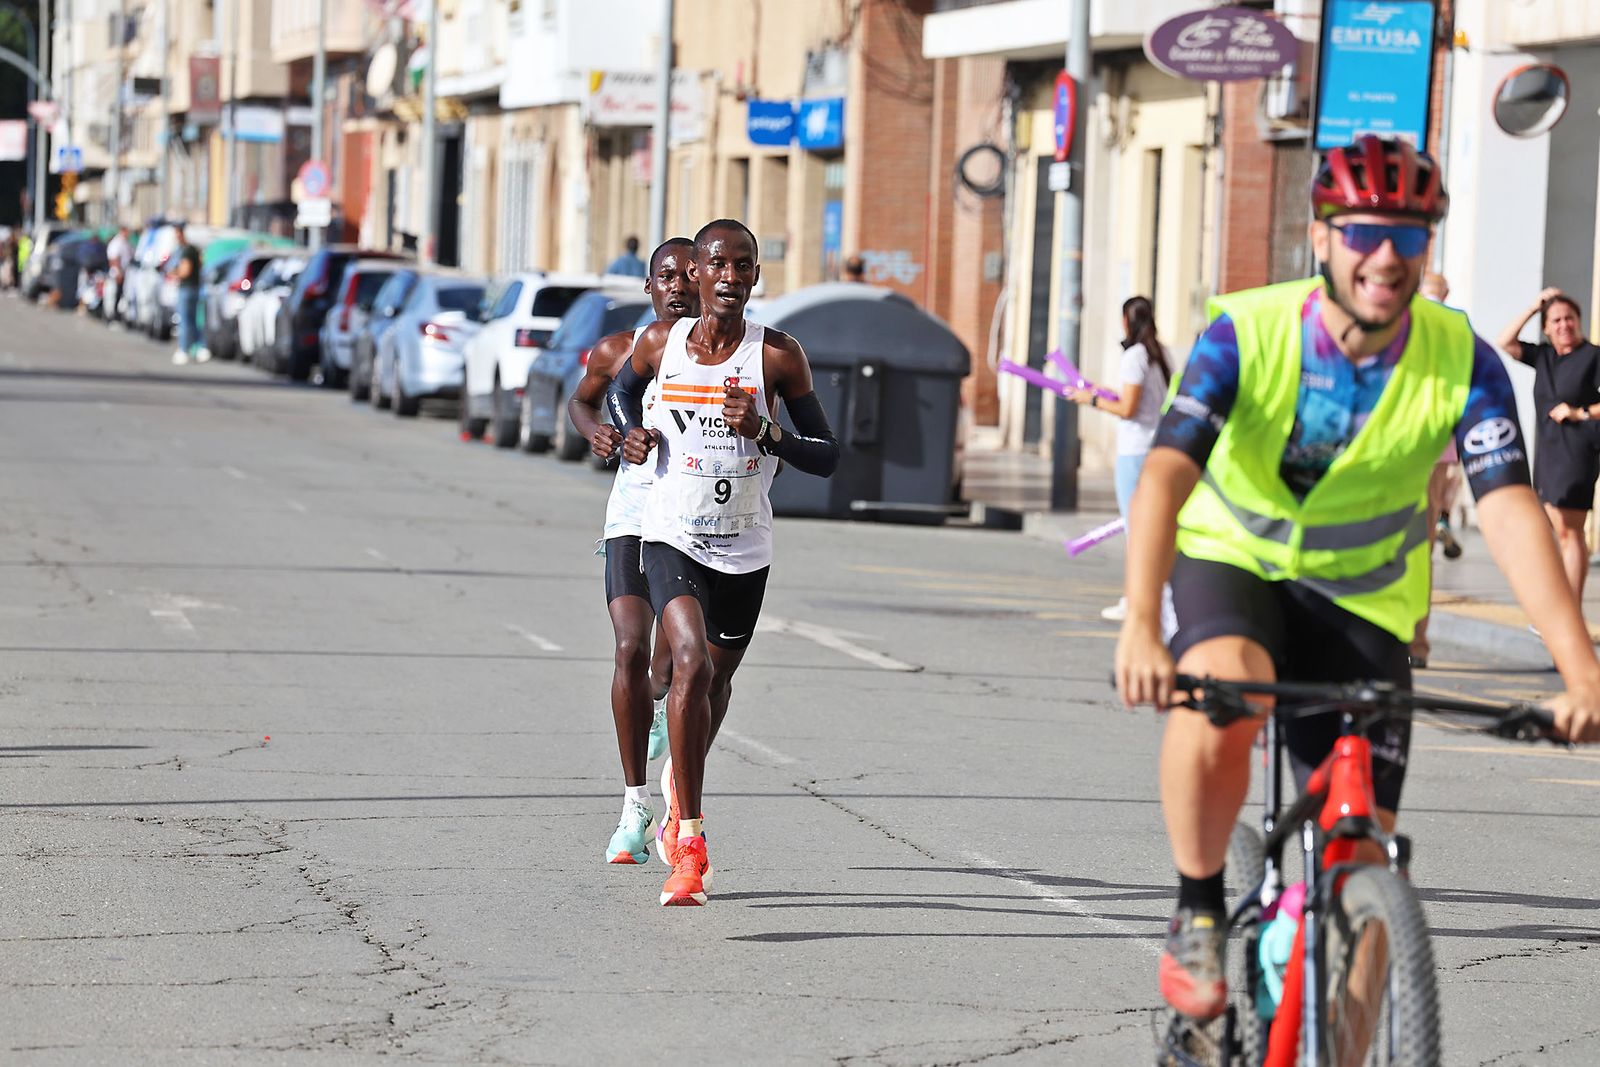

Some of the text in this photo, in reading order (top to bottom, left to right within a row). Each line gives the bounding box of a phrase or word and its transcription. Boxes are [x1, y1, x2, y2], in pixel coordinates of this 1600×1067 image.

[1330, 26, 1421, 48] EMTUSA
[686, 456, 704, 471] 2K
[746, 457, 761, 471] 2K
[1466, 449, 1524, 475] HUELVA
[714, 478, 732, 505] 9
[680, 513, 718, 527] Huelva
